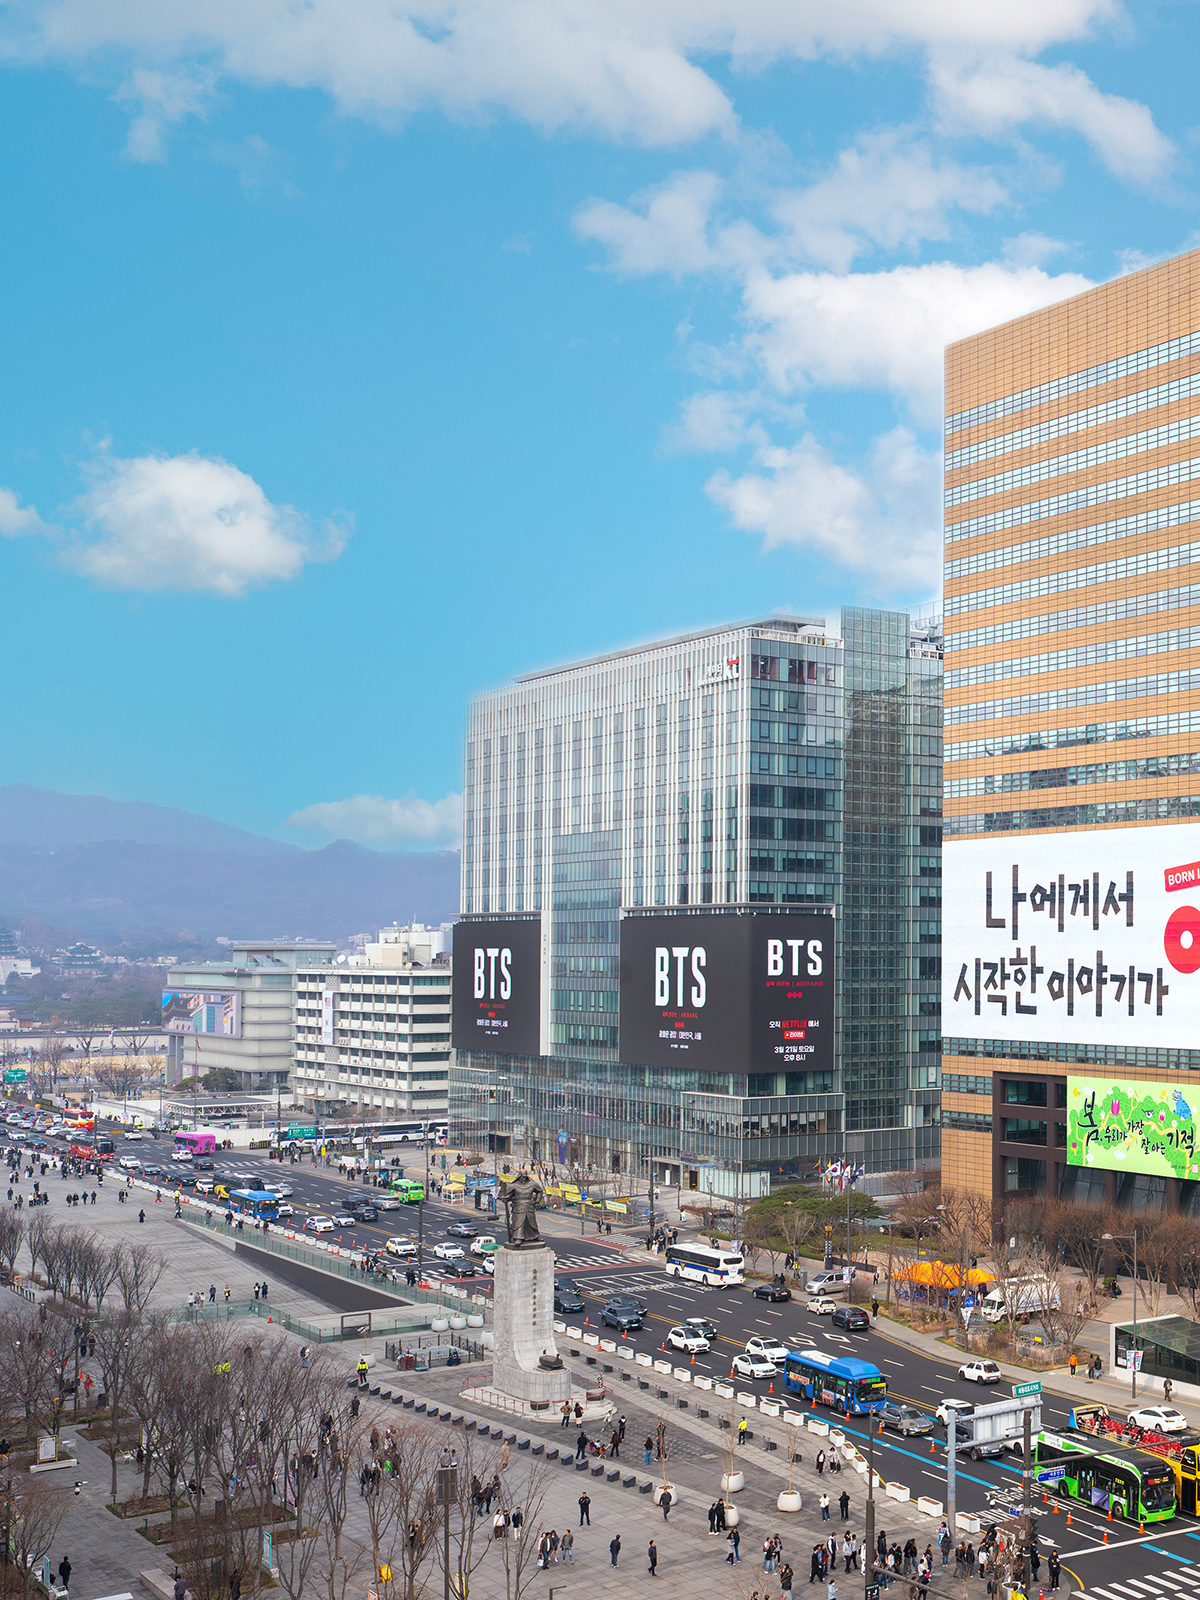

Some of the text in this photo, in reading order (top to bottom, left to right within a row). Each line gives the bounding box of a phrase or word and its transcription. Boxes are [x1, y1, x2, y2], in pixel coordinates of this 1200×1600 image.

[723, 654, 740, 681] kt
[1168, 870, 1195, 886] BORN
[985, 864, 1134, 941] 나에게서
[474, 947, 512, 1000] BTS
[768, 939, 823, 976] BTS
[655, 946, 706, 1008] BTS
[953, 945, 1170, 1017] 시작한 이야기가
[769, 1020, 781, 1029] 오직
[782, 1020, 808, 1029] NETFLIX
[798, 1045, 815, 1053] 토요일
[1104, 1125, 1128, 1144] 우리가
[1127, 1119, 1145, 1136] 가장
[1141, 1126, 1194, 1158] 잘 아는 기적
